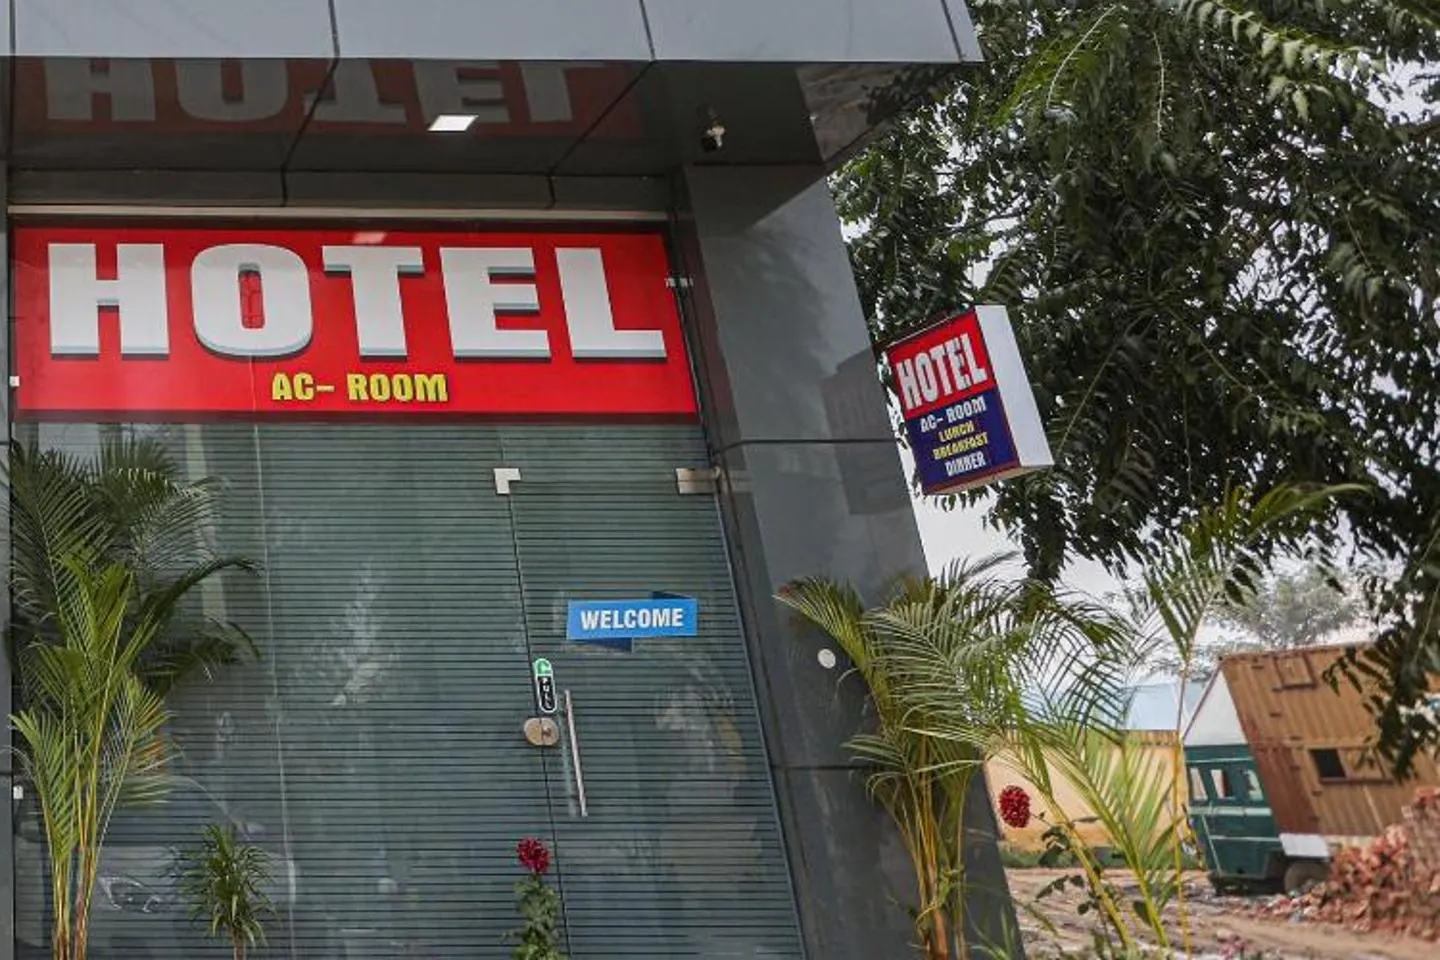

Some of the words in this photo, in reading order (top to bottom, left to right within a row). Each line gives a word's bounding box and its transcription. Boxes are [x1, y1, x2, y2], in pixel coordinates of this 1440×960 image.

[46, 242, 668, 361] HOTEL
[896, 333, 988, 410] HOTEL
[271, 373, 336, 402] AC-
[346, 373, 449, 403] ROOM
[946, 396, 987, 424] ROOM
[938, 420, 975, 442] LUNCH
[945, 451, 987, 477] DINNER
[580, 608, 685, 630] WELCOME
